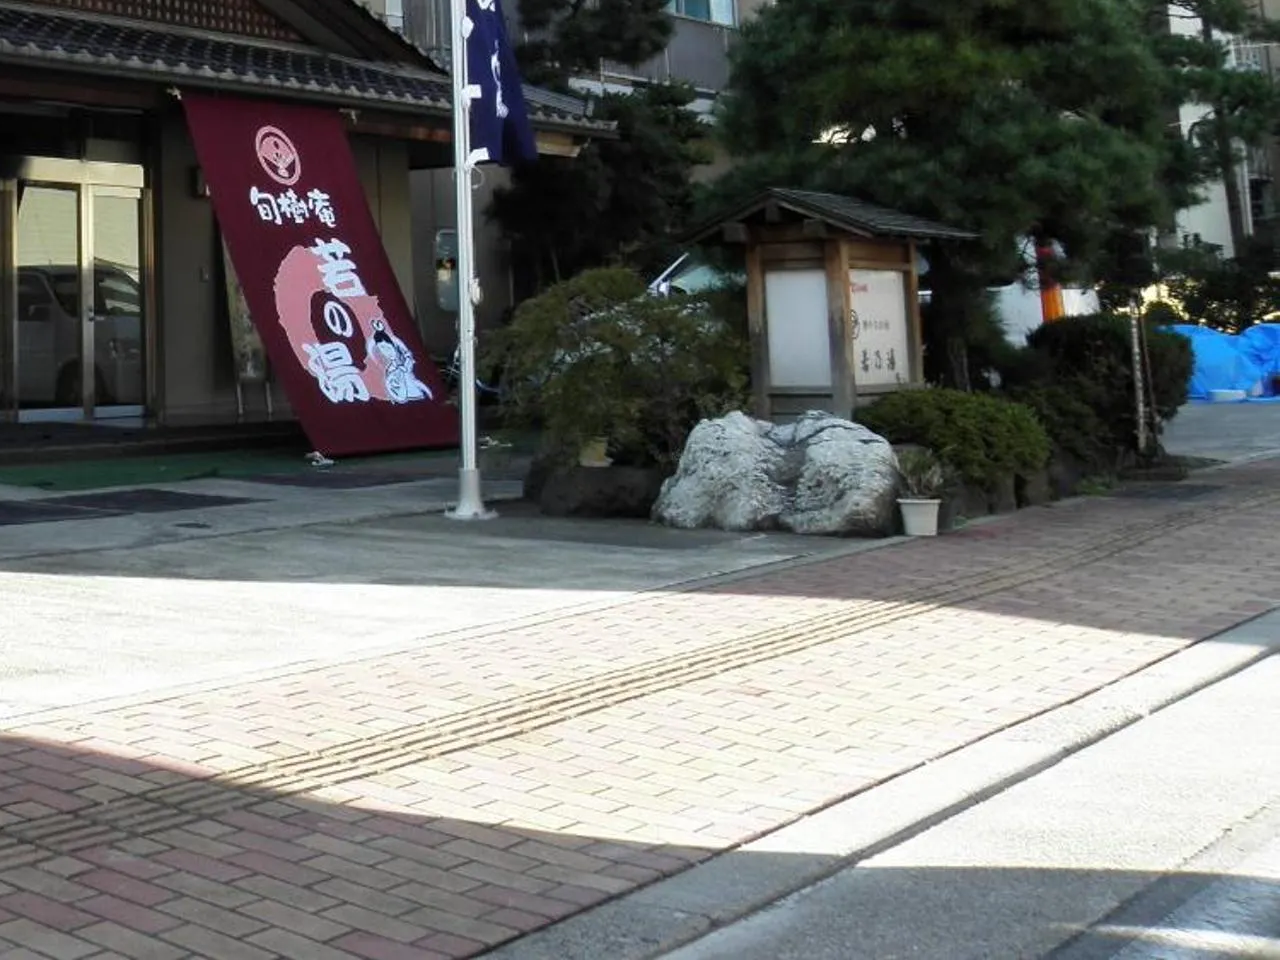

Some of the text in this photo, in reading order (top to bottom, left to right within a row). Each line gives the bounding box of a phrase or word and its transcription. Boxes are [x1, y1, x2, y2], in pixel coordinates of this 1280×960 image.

[250, 186, 337, 227] 旬樹庵
[301, 237, 370, 403] 若の湯
